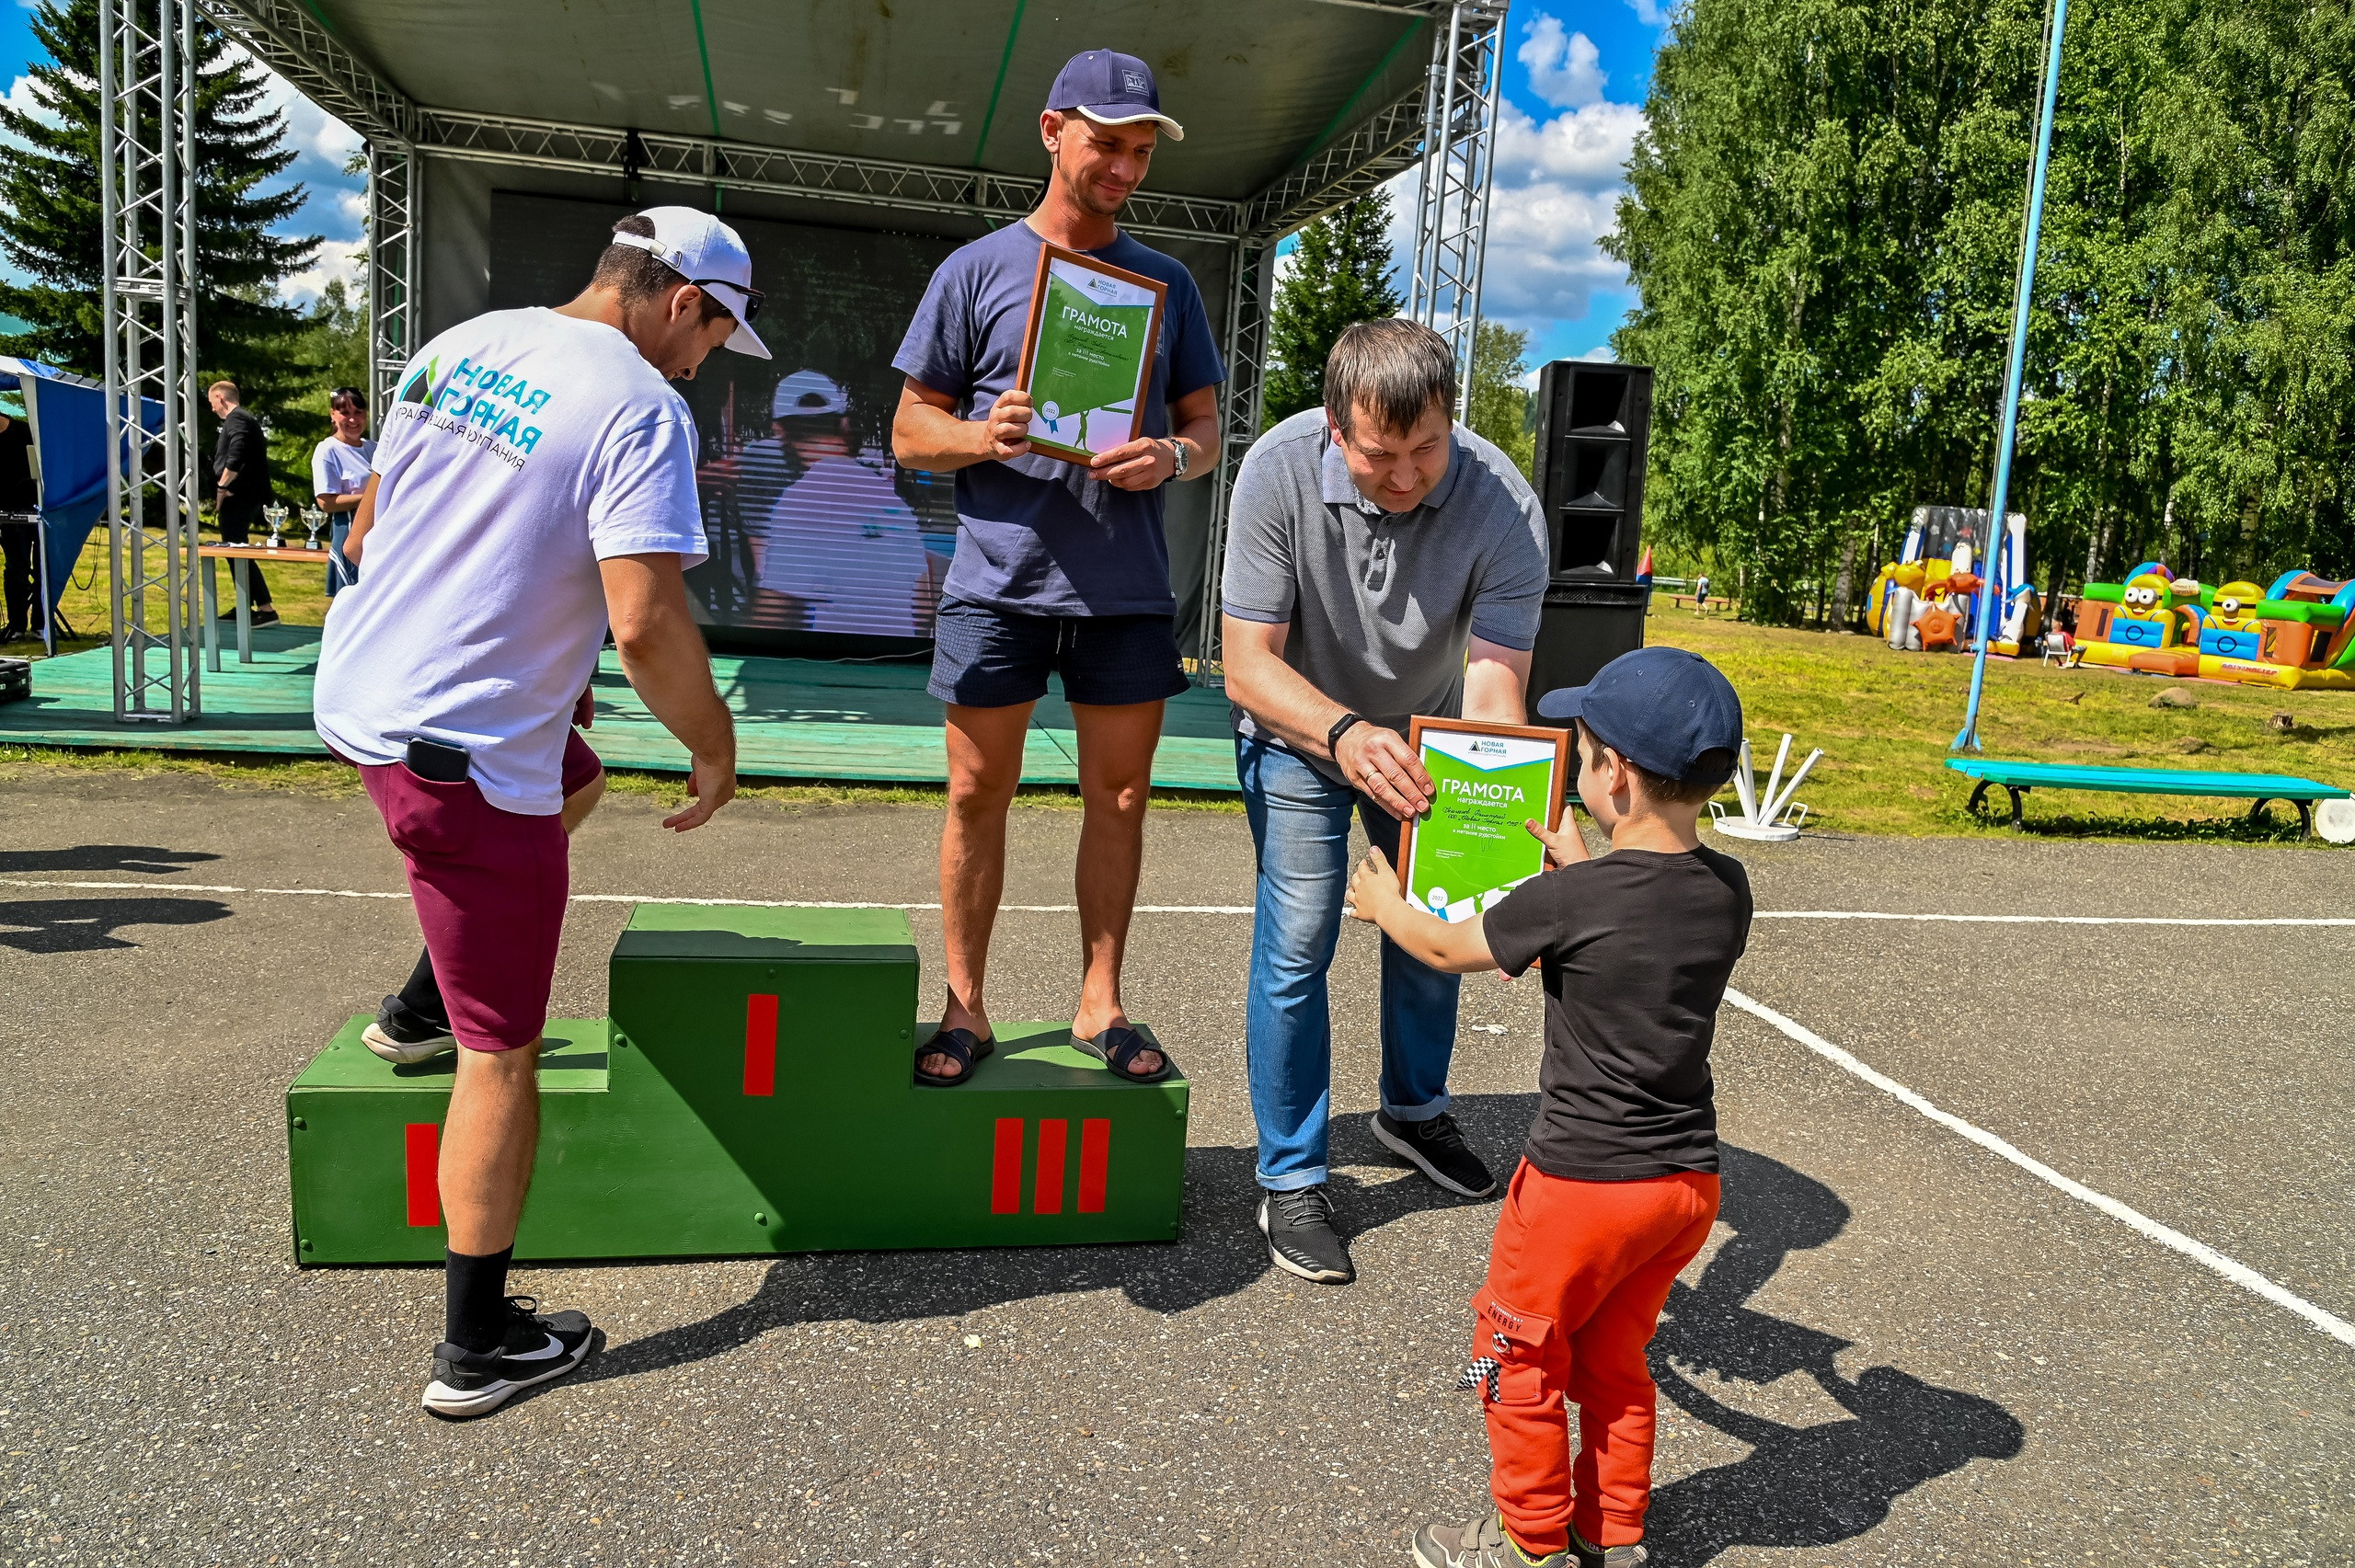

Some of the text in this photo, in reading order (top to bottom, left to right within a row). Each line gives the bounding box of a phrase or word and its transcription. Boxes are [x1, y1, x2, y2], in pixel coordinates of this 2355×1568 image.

[1097, 284, 1118, 295] ГОРНАЯ
[1098, 280, 1116, 289] НОВАЯ
[1062, 306, 1128, 338] ГРАМОТА
[1074, 325, 1114, 341] награждается
[1089, 352, 1105, 361] место
[453, 357, 551, 415] НОВАЯ
[436, 386, 543, 454] ГОРНАЯ
[1442, 778, 1525, 803] ГРАМОТА
[1457, 796, 1508, 808] награждается
[1488, 1305, 1522, 1332] ENERGY
